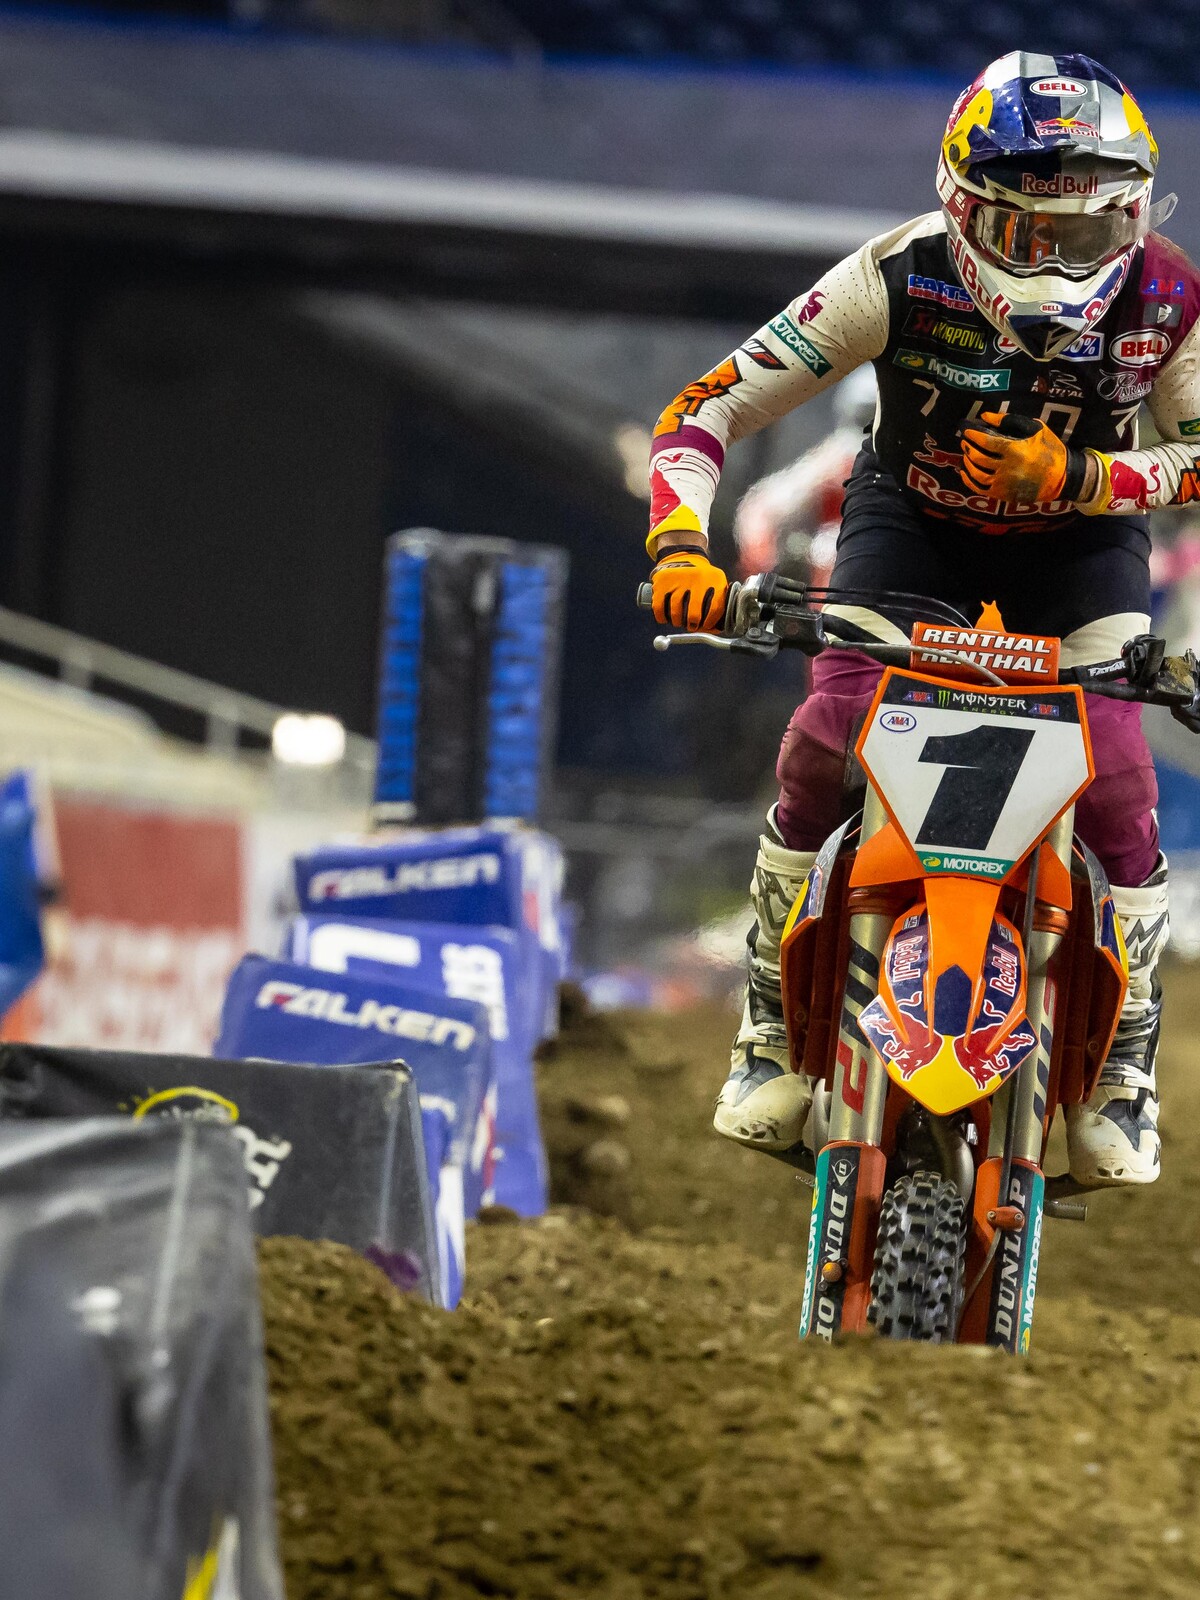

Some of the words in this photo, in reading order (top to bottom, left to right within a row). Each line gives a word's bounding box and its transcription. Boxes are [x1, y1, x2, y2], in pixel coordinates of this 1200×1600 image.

[1038, 83, 1080, 93] BELL
[1036, 127, 1068, 137] Red
[1070, 127, 1099, 138] Bull
[1021, 173, 1060, 194] Red
[1063, 173, 1099, 195] Bull
[1042, 304, 1061, 313] BELL
[1120, 340, 1163, 358] BELL
[927, 358, 1001, 389] MOTOREX
[907, 464, 1000, 516] Red
[922, 628, 1051, 654] RENTHAL
[915, 725, 1036, 851] 1
[307, 853, 499, 904] FALKEN
[942, 857, 1005, 875] MOTOREX
[256, 980, 476, 1051] FALKEN
[994, 1177, 1026, 1341] DUNLP
